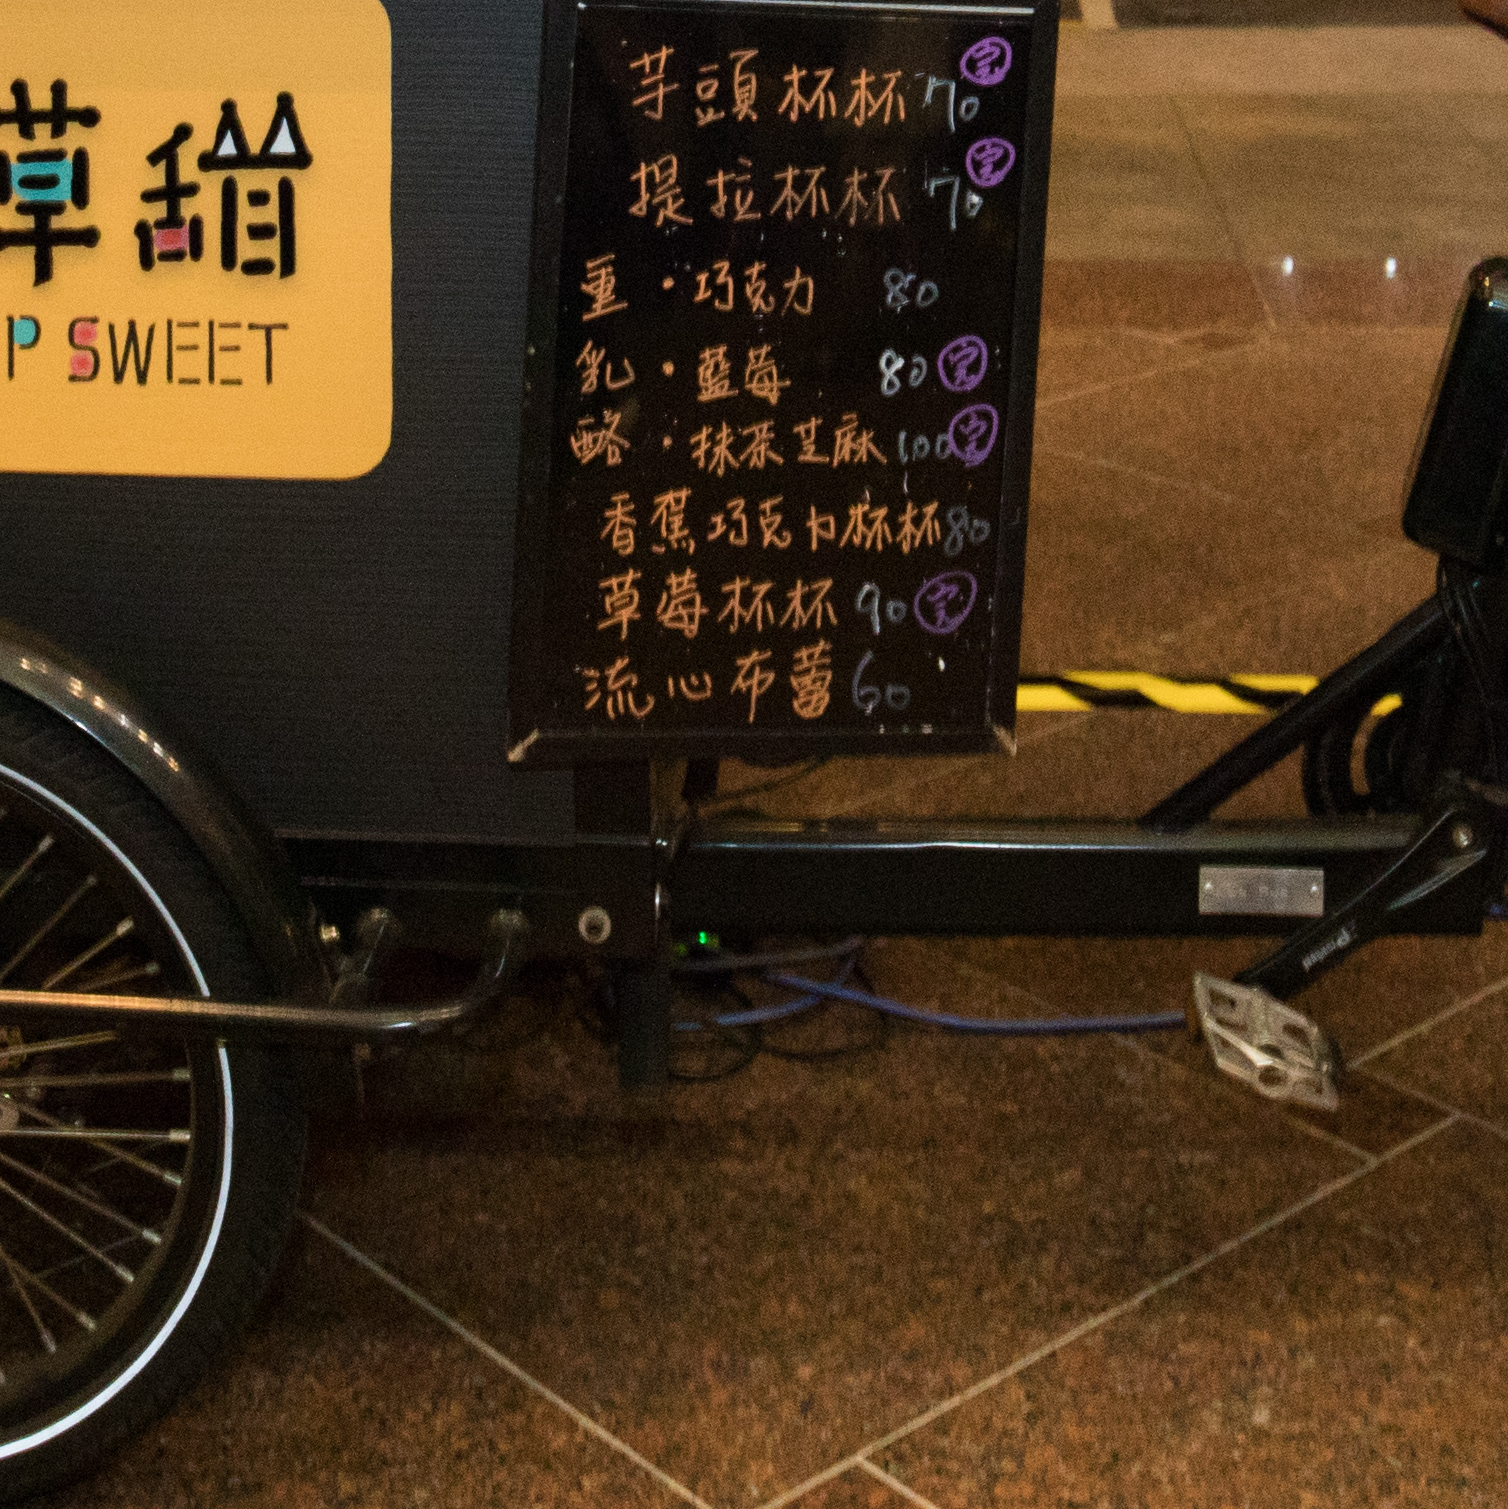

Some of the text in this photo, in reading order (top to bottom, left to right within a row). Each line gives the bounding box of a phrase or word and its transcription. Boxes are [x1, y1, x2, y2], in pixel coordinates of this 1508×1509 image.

[629, 45, 907, 128] 芋頭杯杯
[923, 74, 980, 133] 70
[629, 154, 902, 228] 提拉杯杯
[928, 174, 984, 231] 70
[884, 267, 939, 310] 80
[68, 316, 289, 386] SWEET
[880, 348, 928, 397] 80
[690, 413, 887, 477] 抹茶芝麻
[898, 429, 952, 464] 100
[943, 505, 990, 556] 80
[598, 567, 838, 640] 草莓杯杯
[855, 581, 907, 635] 90
[583, 639, 911, 723] 流心布蕾 60
